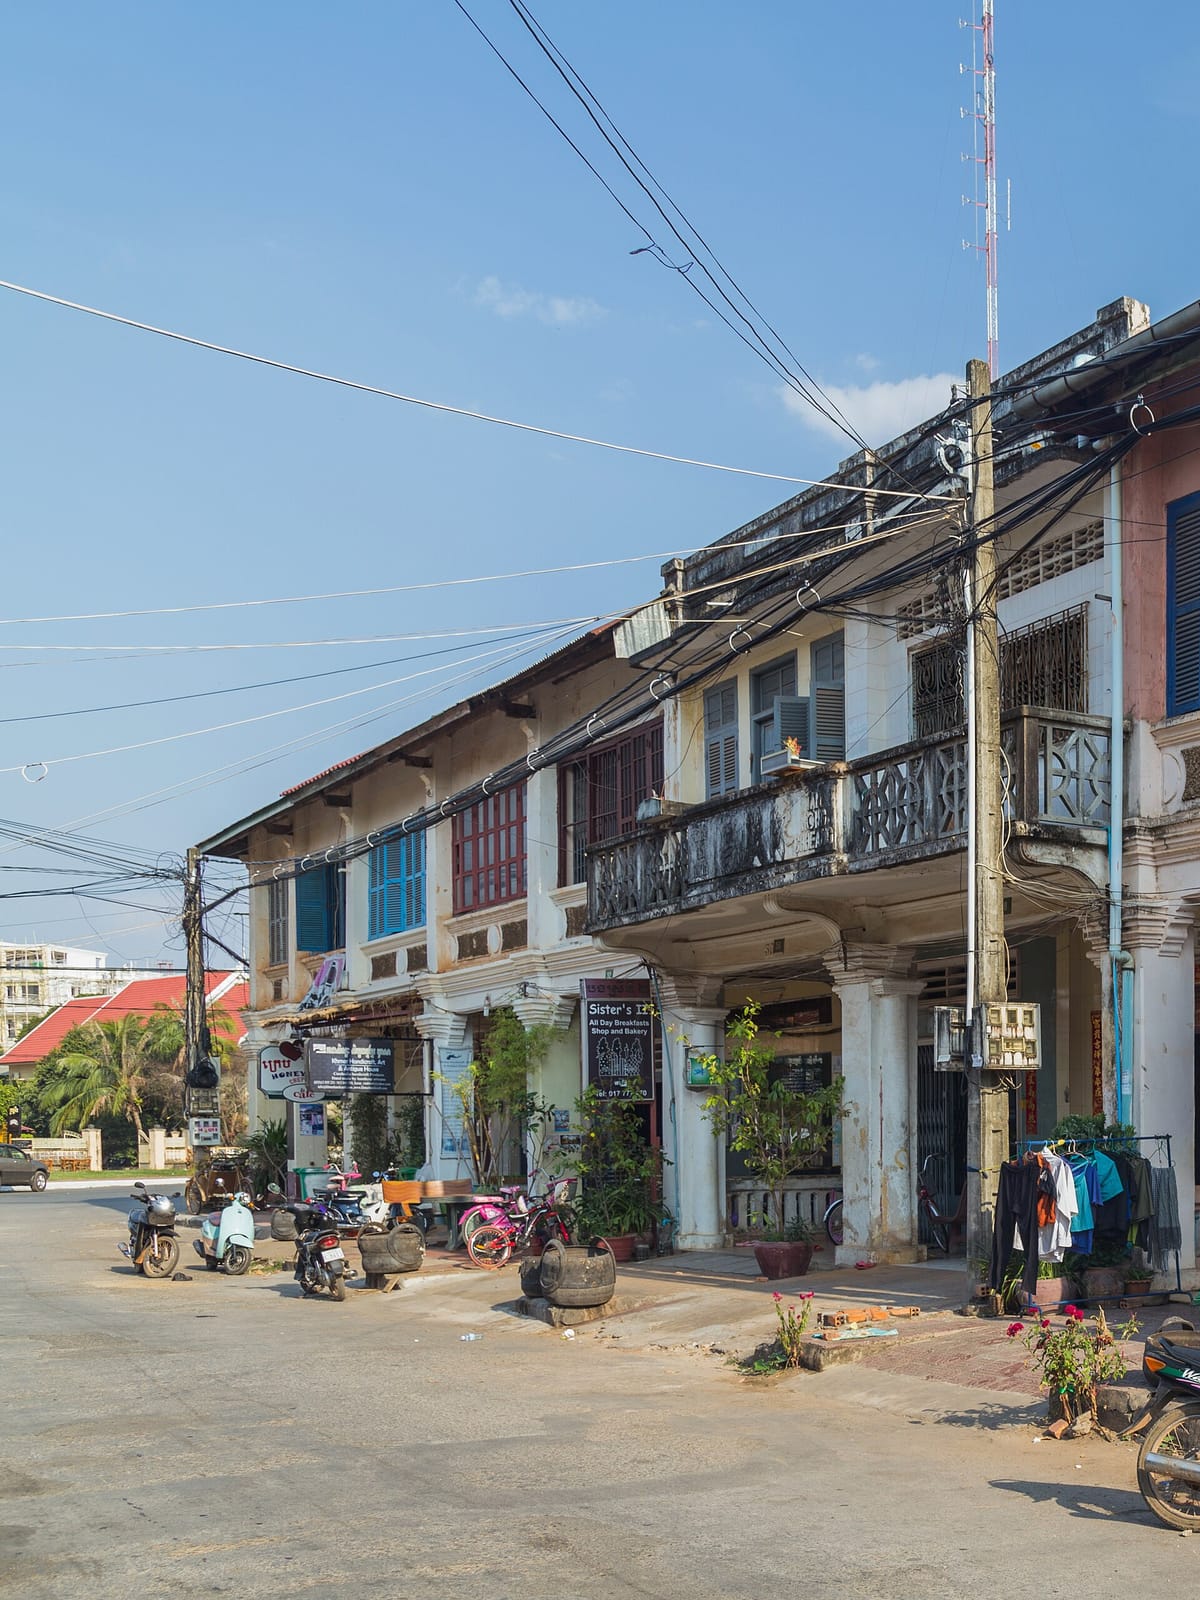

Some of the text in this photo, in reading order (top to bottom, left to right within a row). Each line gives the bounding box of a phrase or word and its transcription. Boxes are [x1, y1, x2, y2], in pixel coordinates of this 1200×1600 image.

[588, 1003, 632, 1015] Sister's
[600, 1019, 613, 1028] Day
[592, 1028, 609, 1036] Shop
[624, 1028, 648, 1036] Bakery
[271, 1070, 305, 1080] HONEY
